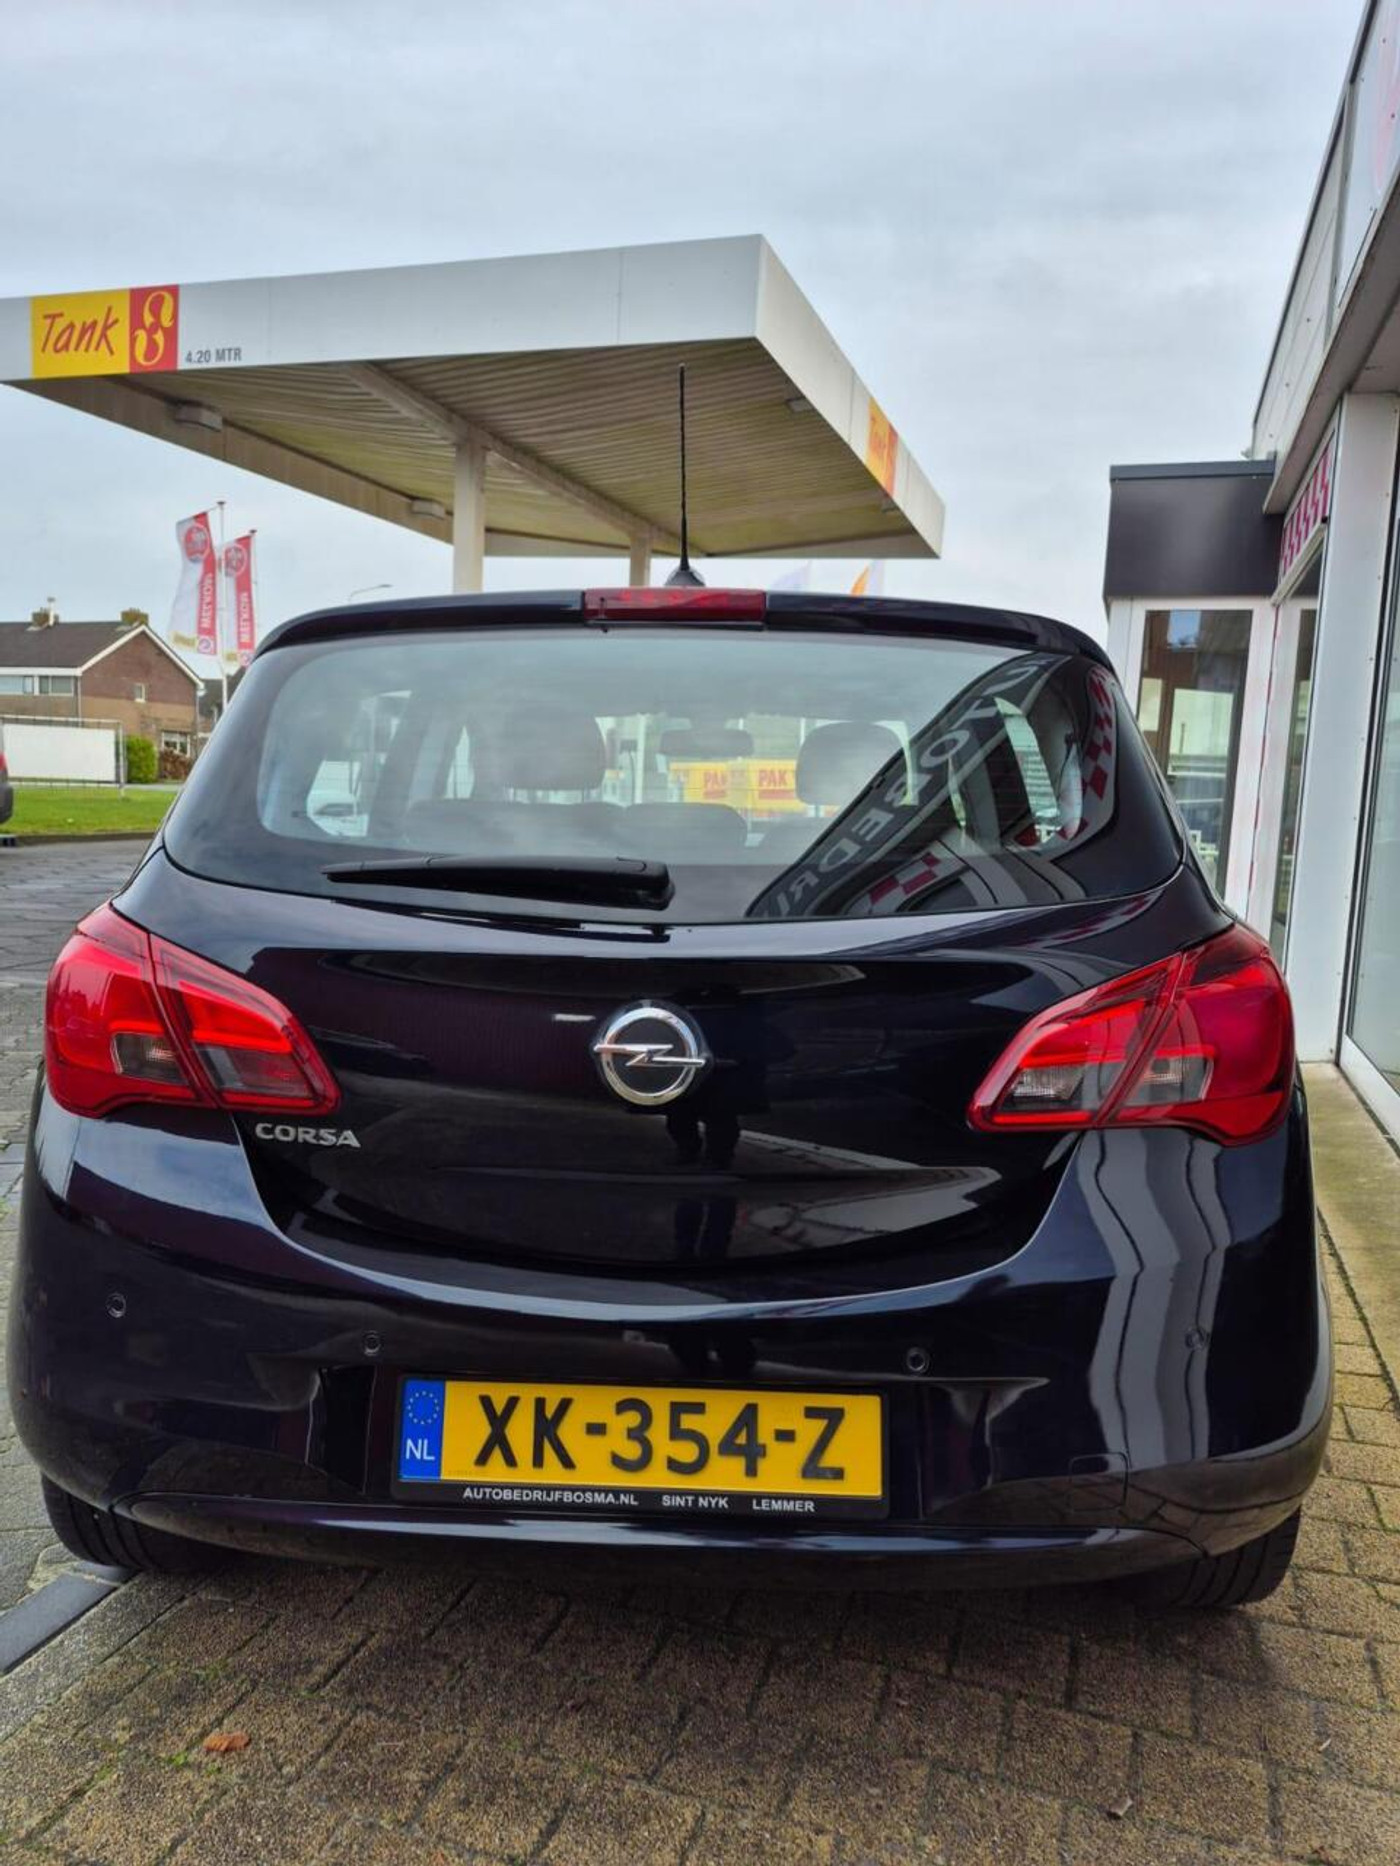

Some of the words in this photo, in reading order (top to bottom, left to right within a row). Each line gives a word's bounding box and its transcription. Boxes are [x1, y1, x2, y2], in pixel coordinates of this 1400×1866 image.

[41, 306, 119, 355] Tank
[186, 349, 212, 364] 4.20
[215, 347, 242, 362] MTR
[758, 769, 789, 788] PAK
[255, 1122, 361, 1148] CORSA
[405, 1438, 436, 1460] NL
[474, 1394, 845, 1480] XK-354-Z
[462, 1487, 639, 1506] AUTOBEDRIJFBOSMA.NL
[661, 1494, 695, 1508] SINT
[698, 1496, 730, 1509] NYK
[752, 1498, 816, 1512] LEMMER
